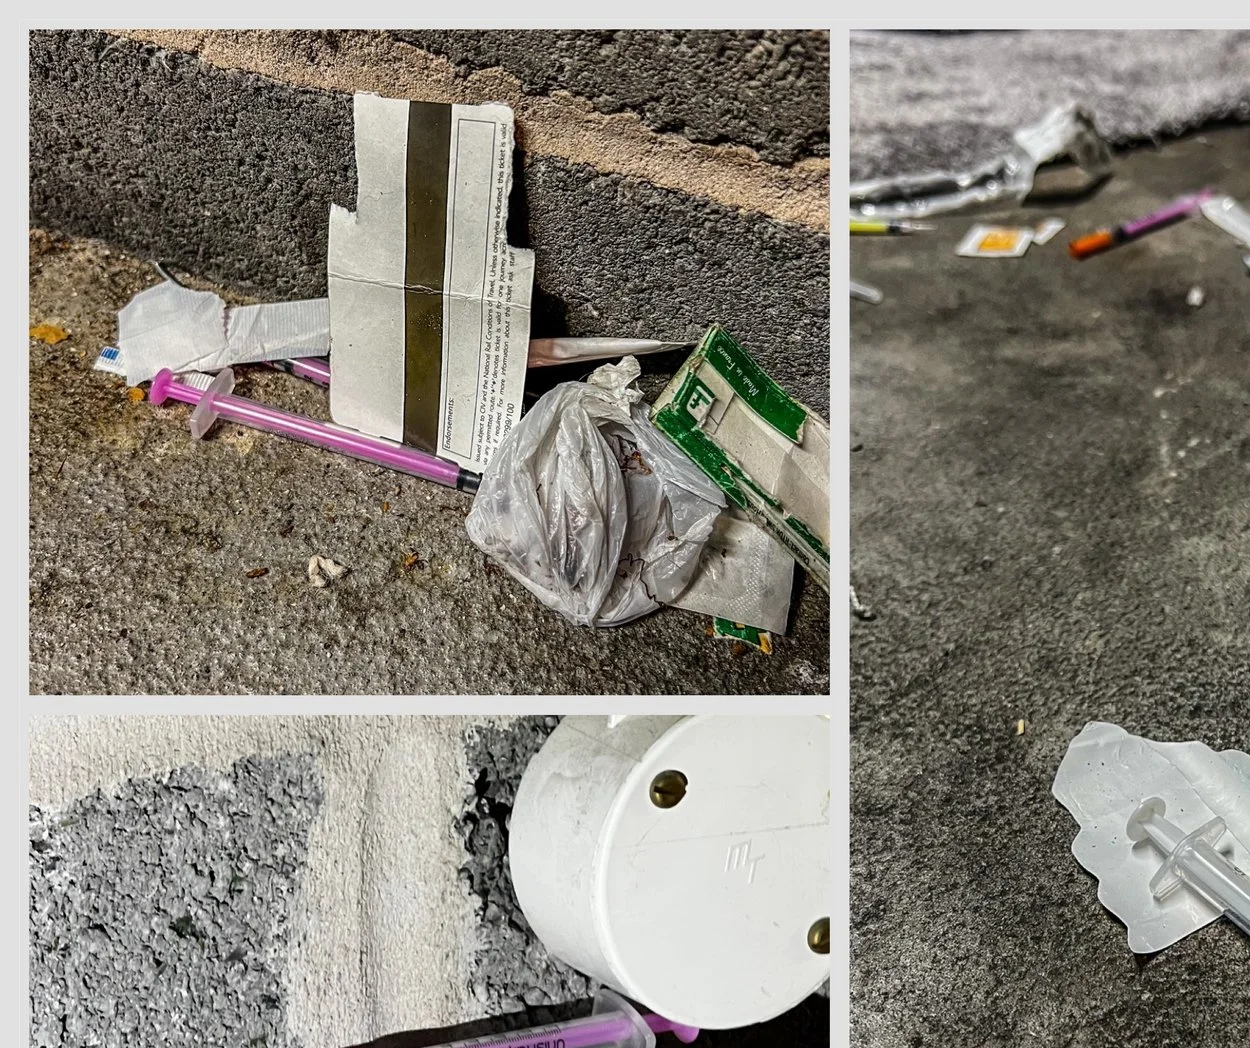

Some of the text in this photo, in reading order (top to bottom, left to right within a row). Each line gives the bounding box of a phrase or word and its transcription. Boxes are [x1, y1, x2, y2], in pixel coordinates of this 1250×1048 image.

[500, 341, 509, 376] information
[716, 345, 735, 370] France
[742, 375, 759, 396] Made
[445, 398, 454, 449] Endorsements:
[478, 422, 486, 443] subject
[486, 414, 494, 443] permitted
